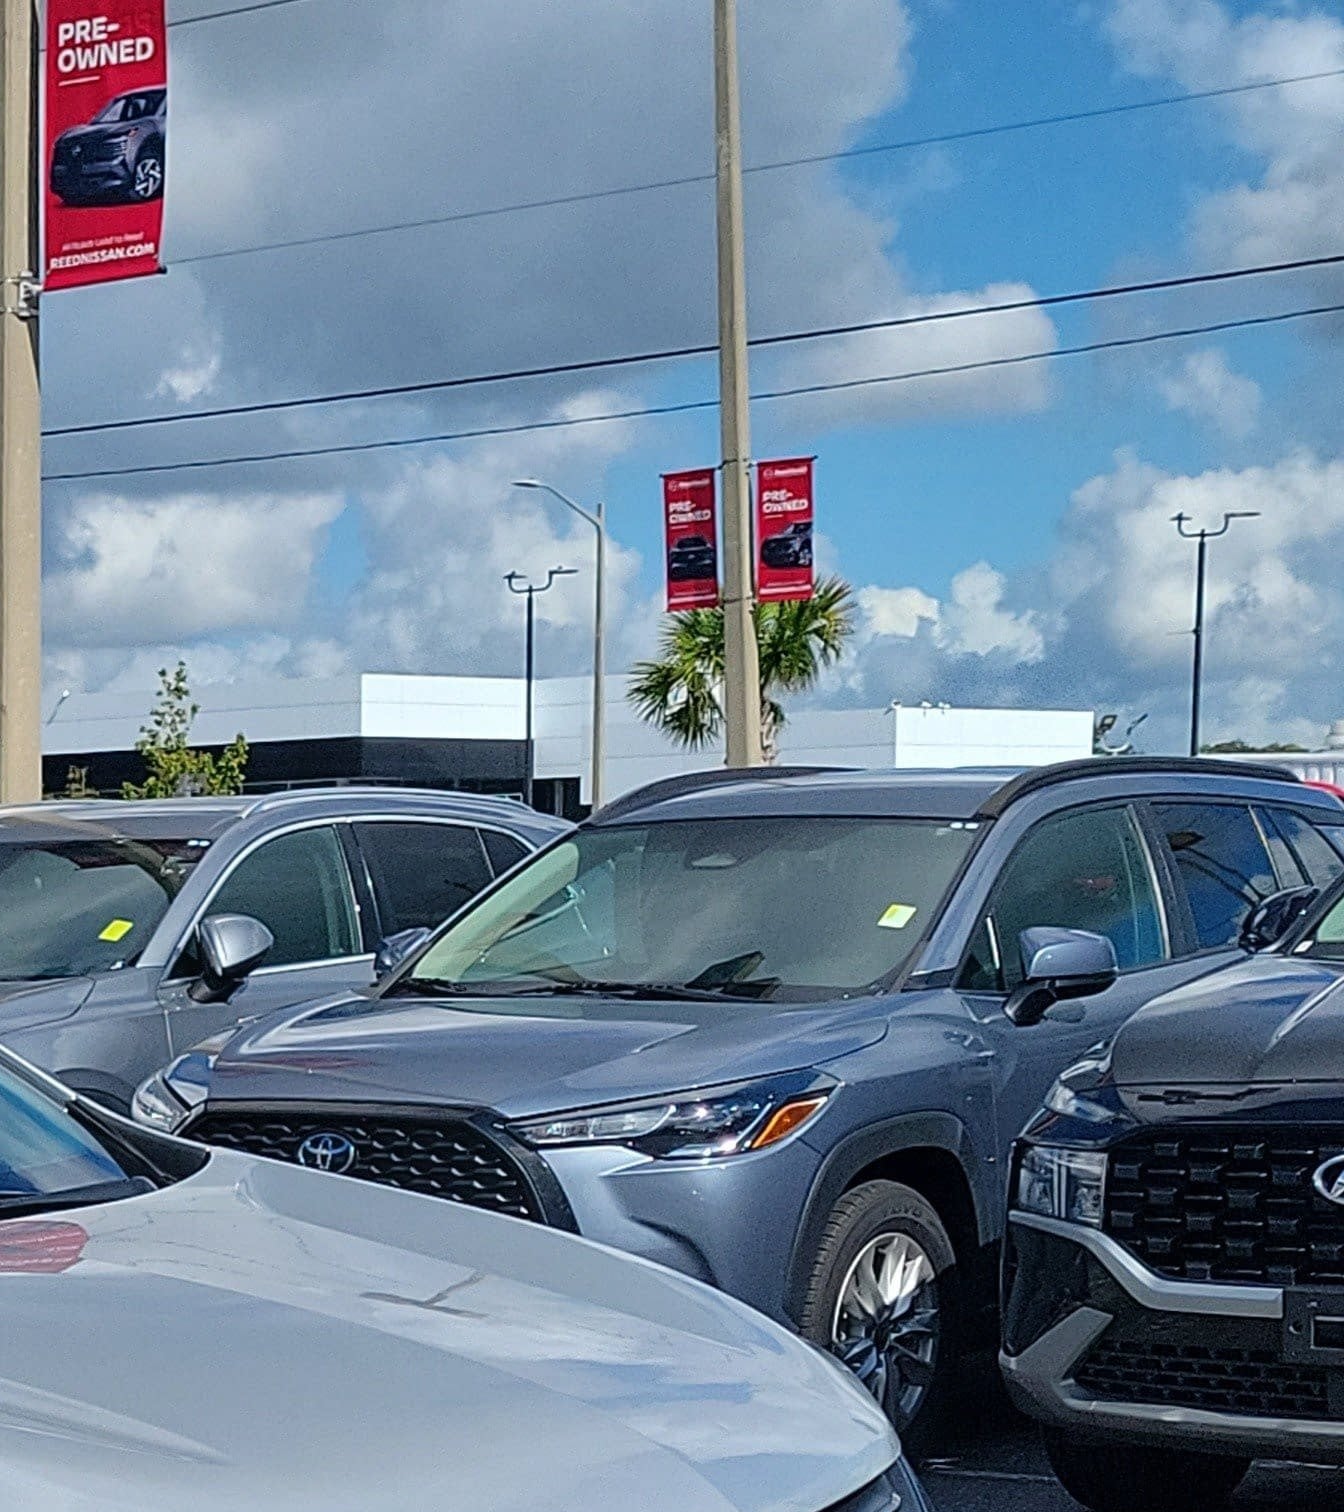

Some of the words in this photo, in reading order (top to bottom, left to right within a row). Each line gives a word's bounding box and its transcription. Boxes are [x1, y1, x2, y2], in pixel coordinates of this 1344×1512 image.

[59, 16, 120, 47] PRE-
[58, 37, 154, 73] OWNED
[50, 243, 155, 269] REEDNISSAN.COM
